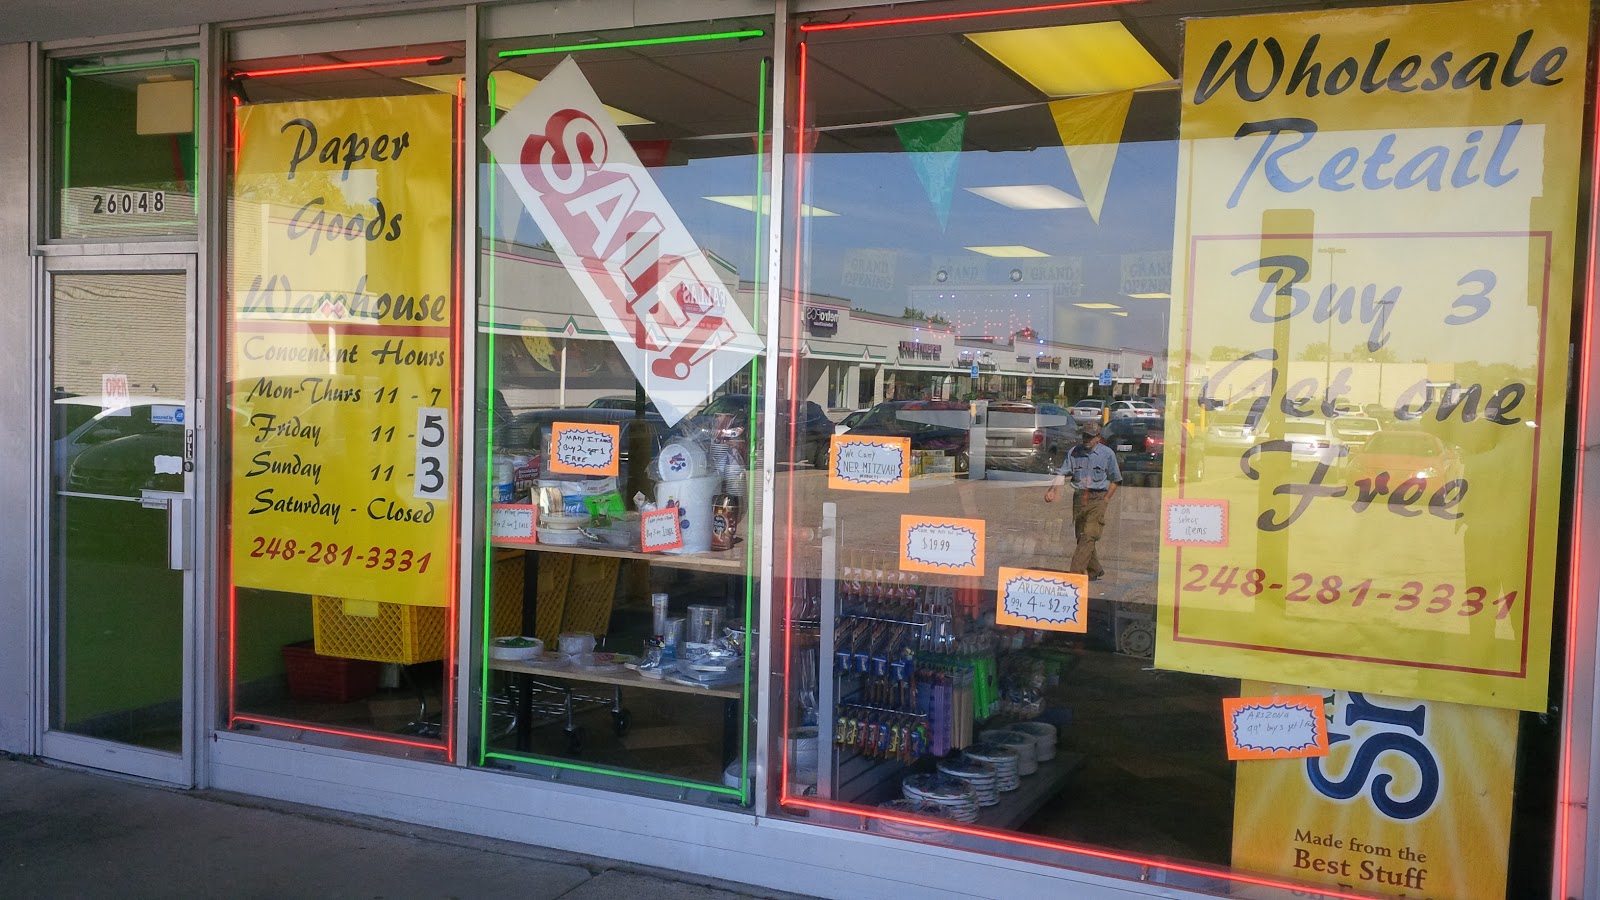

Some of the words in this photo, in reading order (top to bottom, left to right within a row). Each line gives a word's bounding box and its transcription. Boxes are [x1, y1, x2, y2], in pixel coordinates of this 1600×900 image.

[1194, 29, 1568, 105] Wholesale
[280, 118, 410, 181] Paper
[1226, 118, 1523, 209] Retail
[93, 192, 163, 213] 26048
[287, 197, 403, 256] Goods
[520, 109, 737, 380] SALE!
[1230, 255, 1402, 352] Buy
[1444, 269, 1497, 325] 3
[243, 336, 358, 364] Convenient
[371, 339, 445, 366] Hours
[106, 378, 127, 398] OPEN
[246, 377, 361, 404] Mon-Thurs
[374, 386, 399, 404] 11
[430, 387, 441, 406] 7
[1198, 349, 1353, 433] Get
[1394, 380, 1526, 427] one
[250, 413, 322, 447] Friday
[371, 425, 395, 443] 11
[421, 415, 445, 447] 5
[577, 445, 587, 453] 2
[245, 451, 322, 485] Sunday
[370, 464, 394, 481] 11
[420, 456, 444, 493] 3
[843, 461, 859, 473] NER
[862, 461, 896, 475] MITZVAH
[1240, 439, 1469, 531] Free
[248, 488, 341, 525] Saturday
[367, 497, 435, 524] Closed
[250, 536, 432, 574] 248-281-3331
[1018, 582, 1056, 596] ARIZONA
[1027, 596, 1037, 612] 4
[1183, 563, 1518, 620] 248-281-3331
[1294, 828, 1343, 849] Made
[1349, 837, 1392, 858] from
[1398, 846, 1427, 863] the
[1293, 848, 1350, 877] Best
[1359, 860, 1428, 890] Stuff
